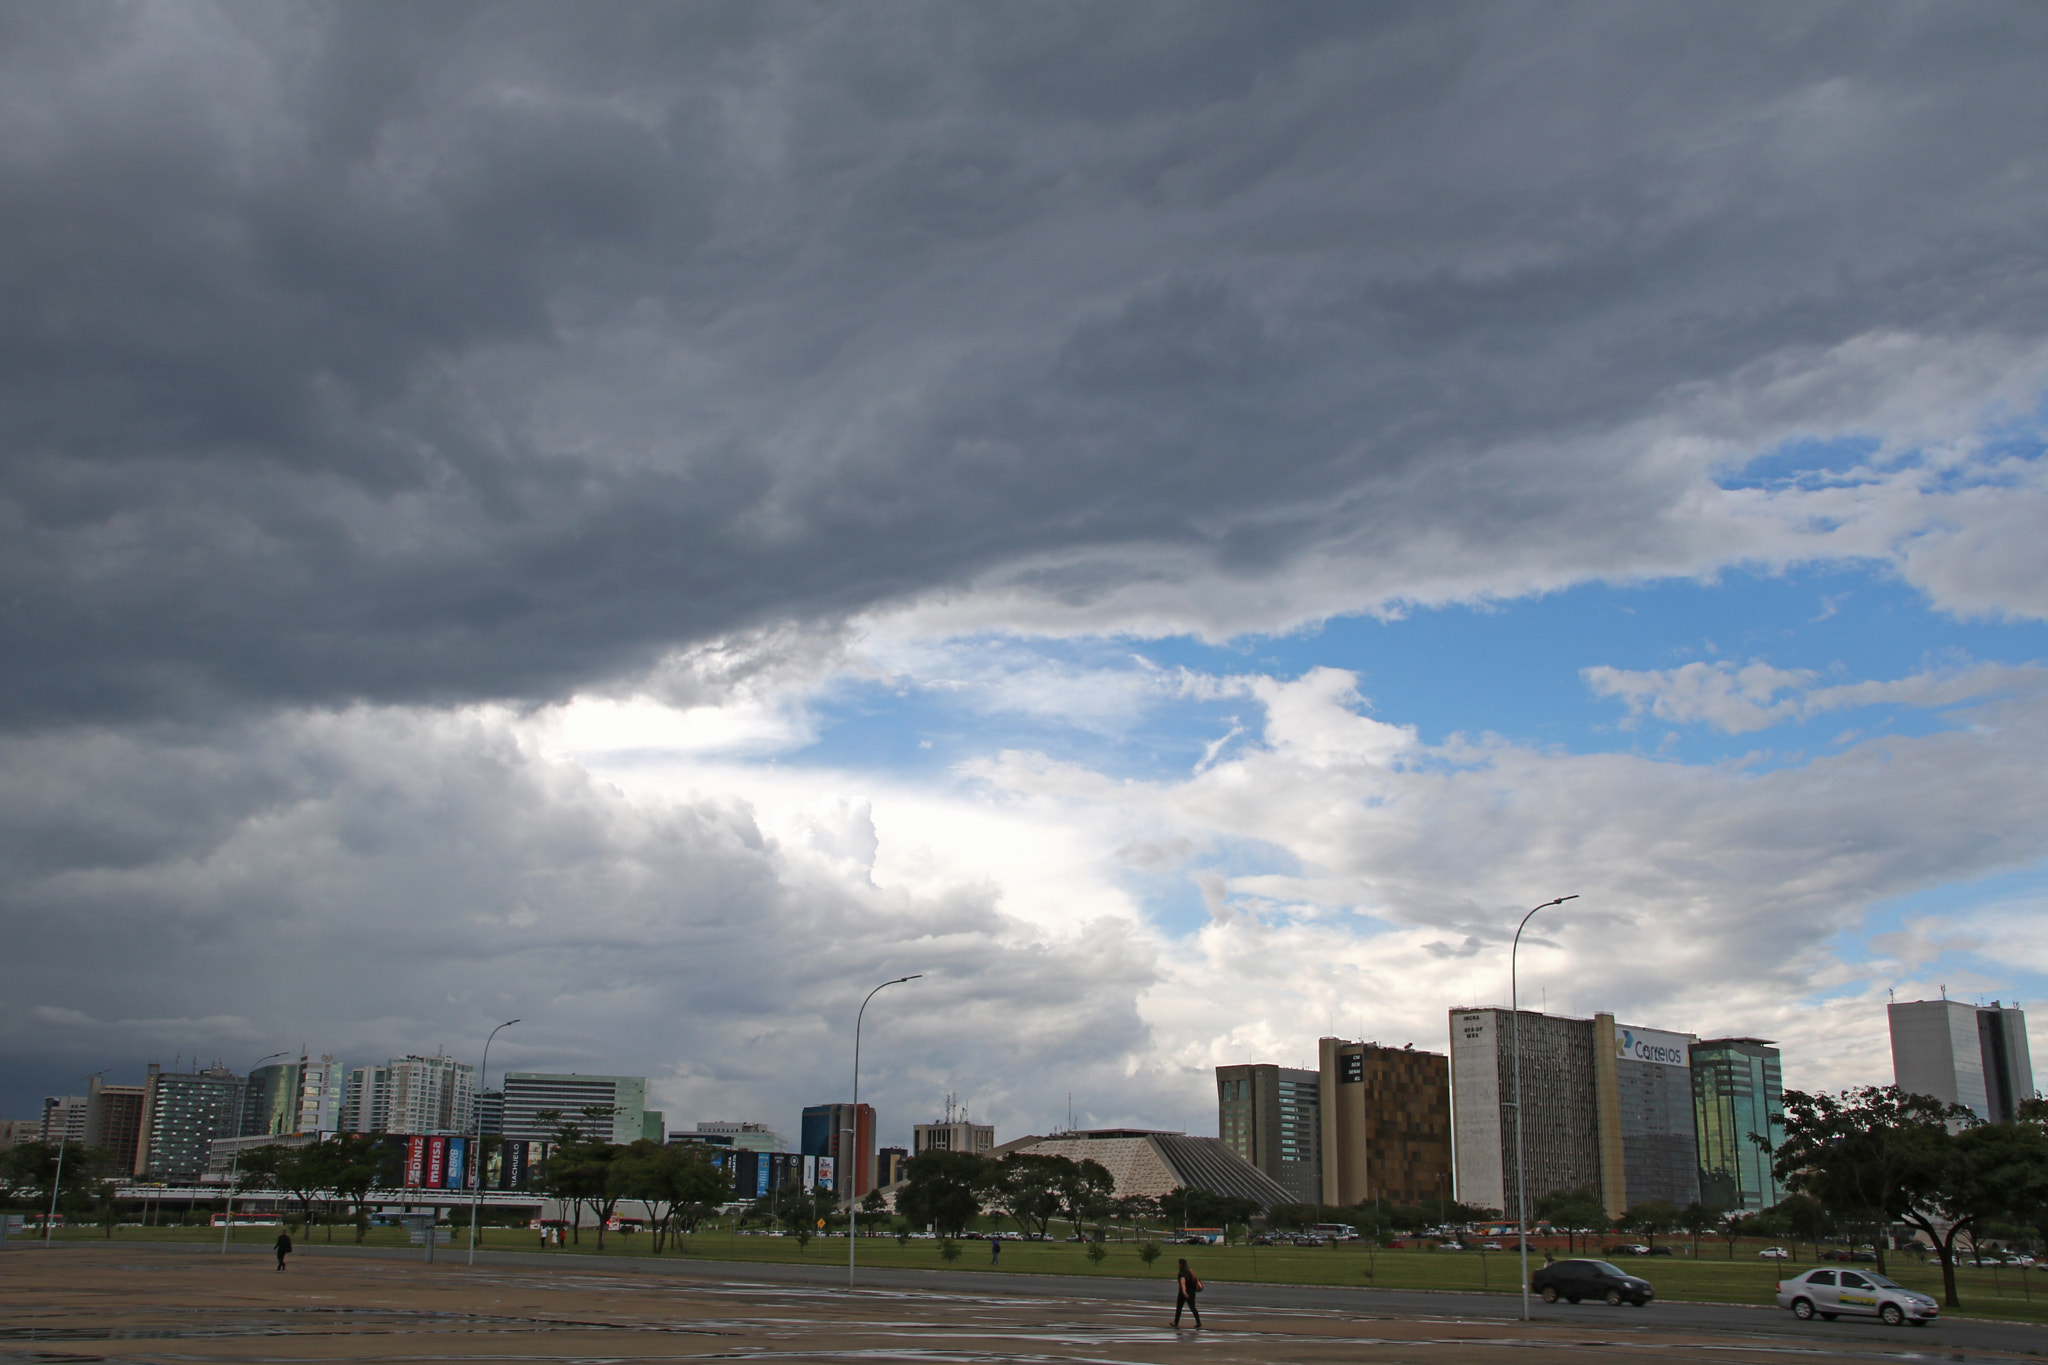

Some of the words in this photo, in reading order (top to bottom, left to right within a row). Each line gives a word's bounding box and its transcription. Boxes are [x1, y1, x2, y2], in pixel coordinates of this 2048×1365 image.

[1635, 1041, 1681, 1063] Correios
[322, 1064, 331, 1095] WINDSOR
[413, 1138, 423, 1170] DINIZ
[430, 1141, 441, 1183] marisa
[449, 1148, 459, 1168] BRB
[510, 1143, 520, 1188] RIACHUELO
